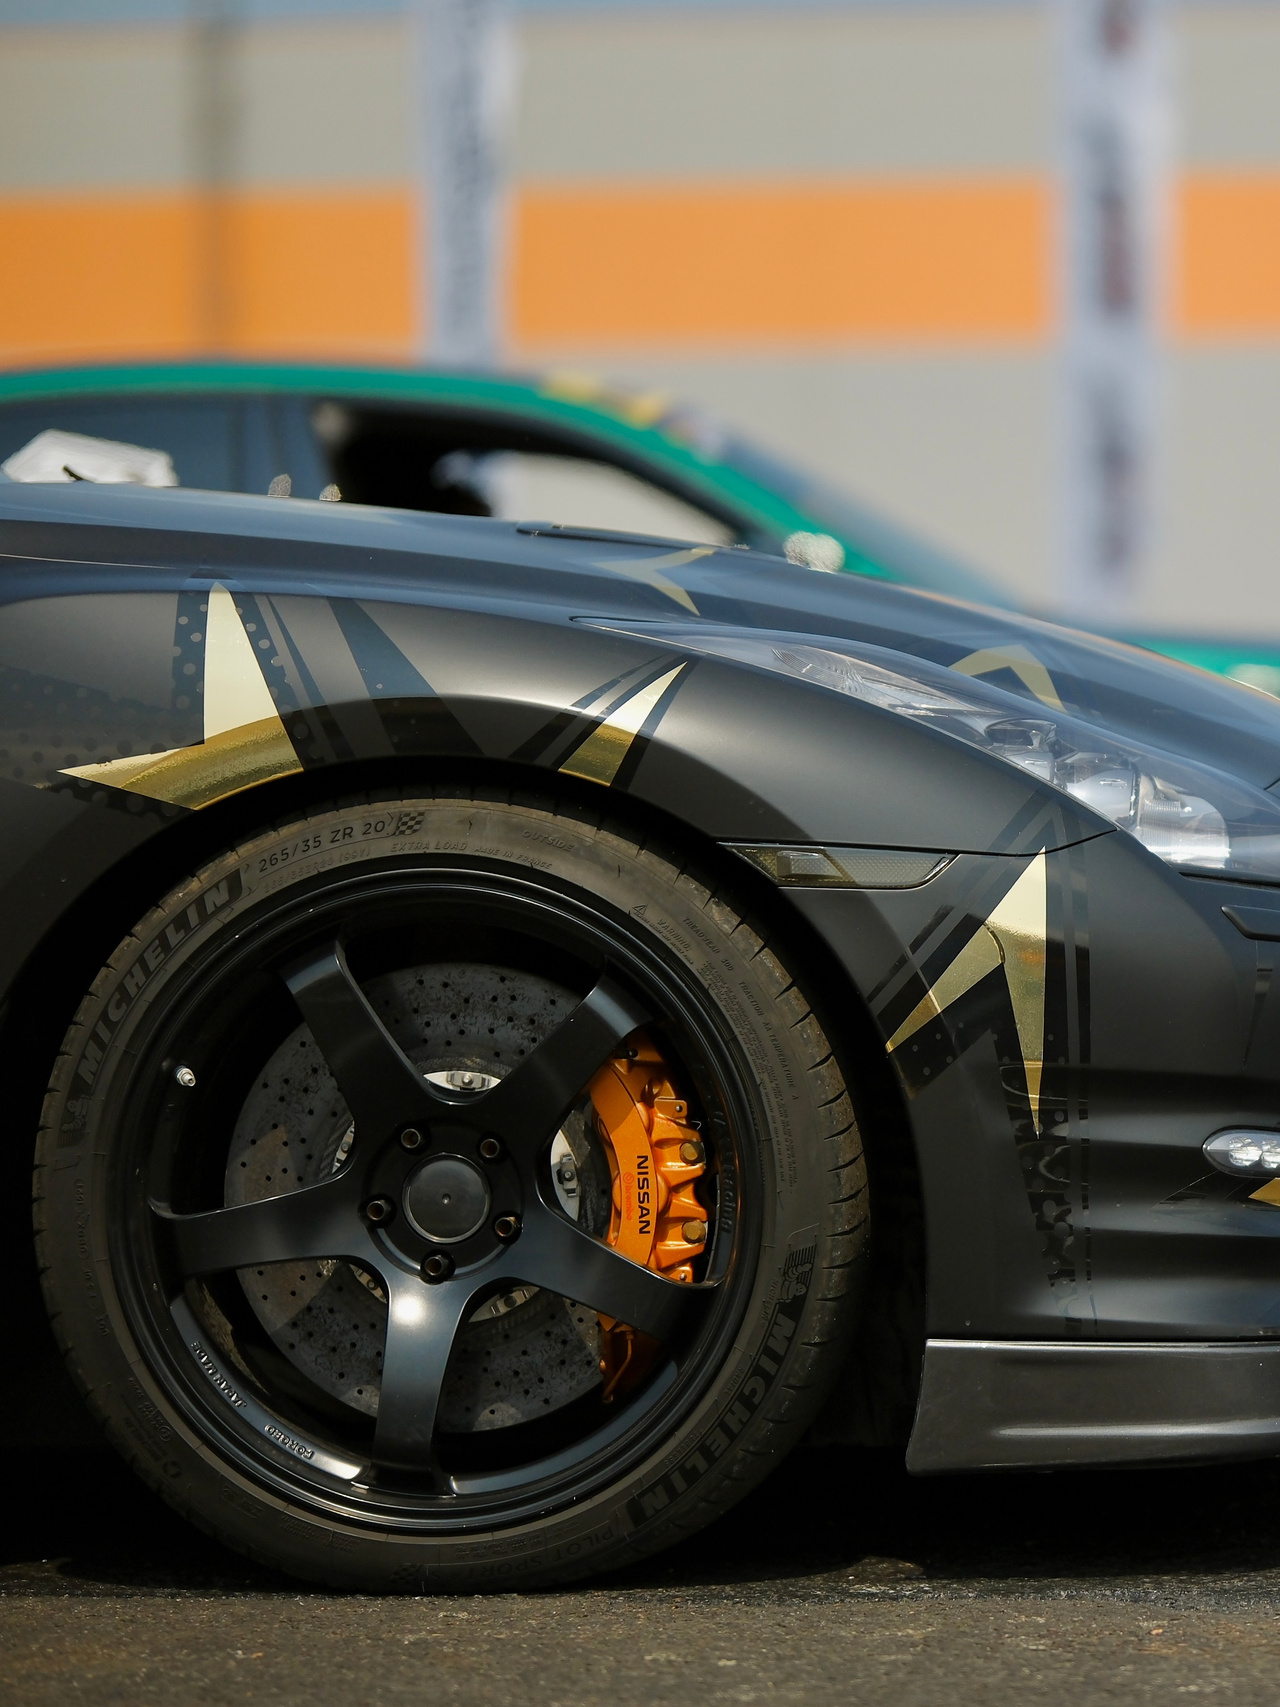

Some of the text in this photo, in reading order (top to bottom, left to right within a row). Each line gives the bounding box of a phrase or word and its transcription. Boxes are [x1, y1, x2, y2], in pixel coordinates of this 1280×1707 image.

[254, 819, 386, 873] 265/35 ZR 20
[388, 840, 467, 853] EXTRA LOAD
[473, 845, 553, 870] MADE IN FRANCE
[520, 828, 575, 854] OUTSIDE
[74, 878, 236, 1086] MICHELIN
[737, 979, 765, 1017] TRACTION
[624, 1184, 634, 1221] brembo
[636, 1155, 651, 1235] NISSAN
[188, 1338, 249, 1412] JAPAN MADE
[722, 1363, 746, 1397] RADIAL
[635, 1311, 798, 1519] MICHELIN
[261, 1420, 316, 1462] FORGED
[661, 1431, 699, 1468] TUBELESS
[550, 1525, 615, 1562] PILOT
[465, 1554, 543, 1579] SPORT
